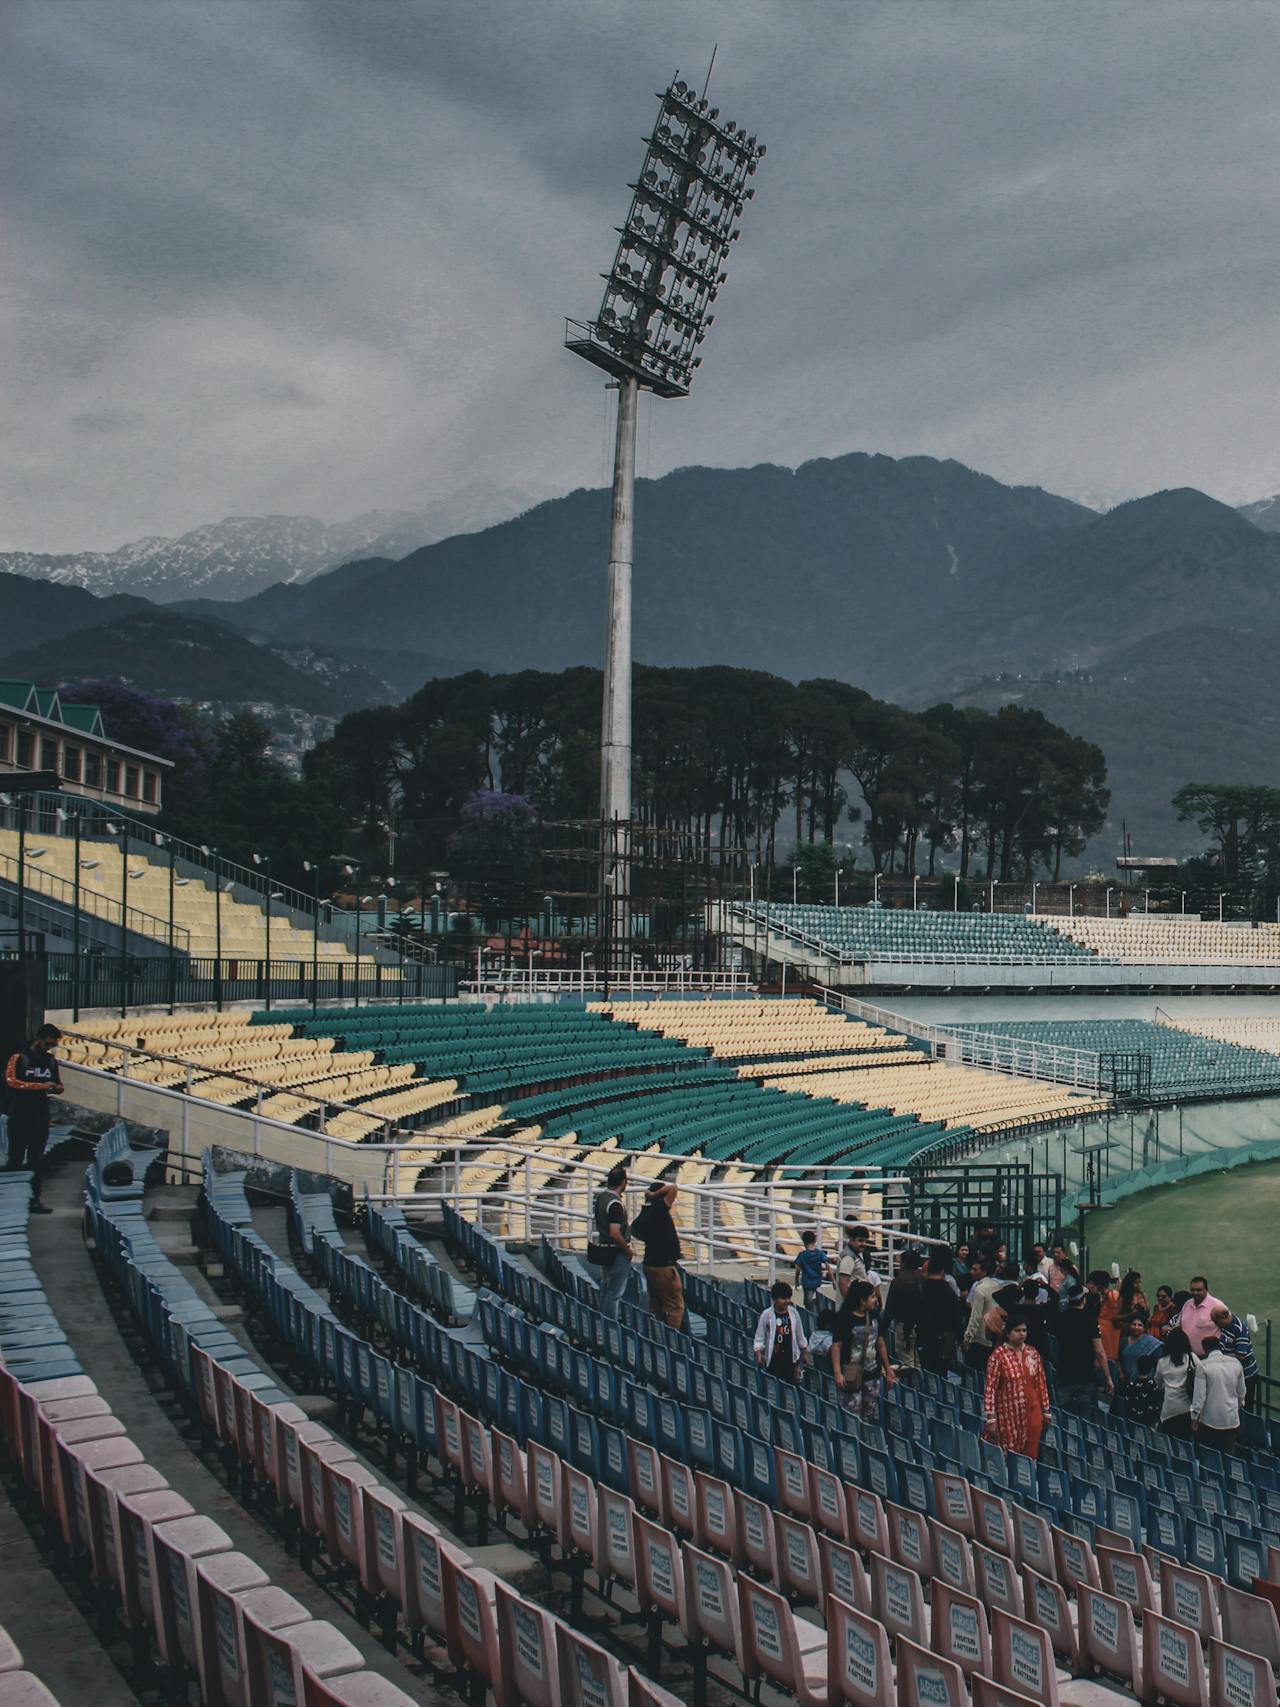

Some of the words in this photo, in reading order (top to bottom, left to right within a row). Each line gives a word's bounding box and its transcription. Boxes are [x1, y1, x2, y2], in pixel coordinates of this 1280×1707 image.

[25, 1067, 51, 1078] FILA
[953, 1611, 977, 1632] ARISE
[850, 1633, 874, 1662] ARISE
[1013, 1635, 1039, 1661] ARISE
[851, 1657, 872, 1677] INVERTERS
[1015, 1658, 1038, 1676] INVERTERS
[1226, 1662, 1252, 1690] ARISE
[919, 1679, 946, 1700] ARISE
